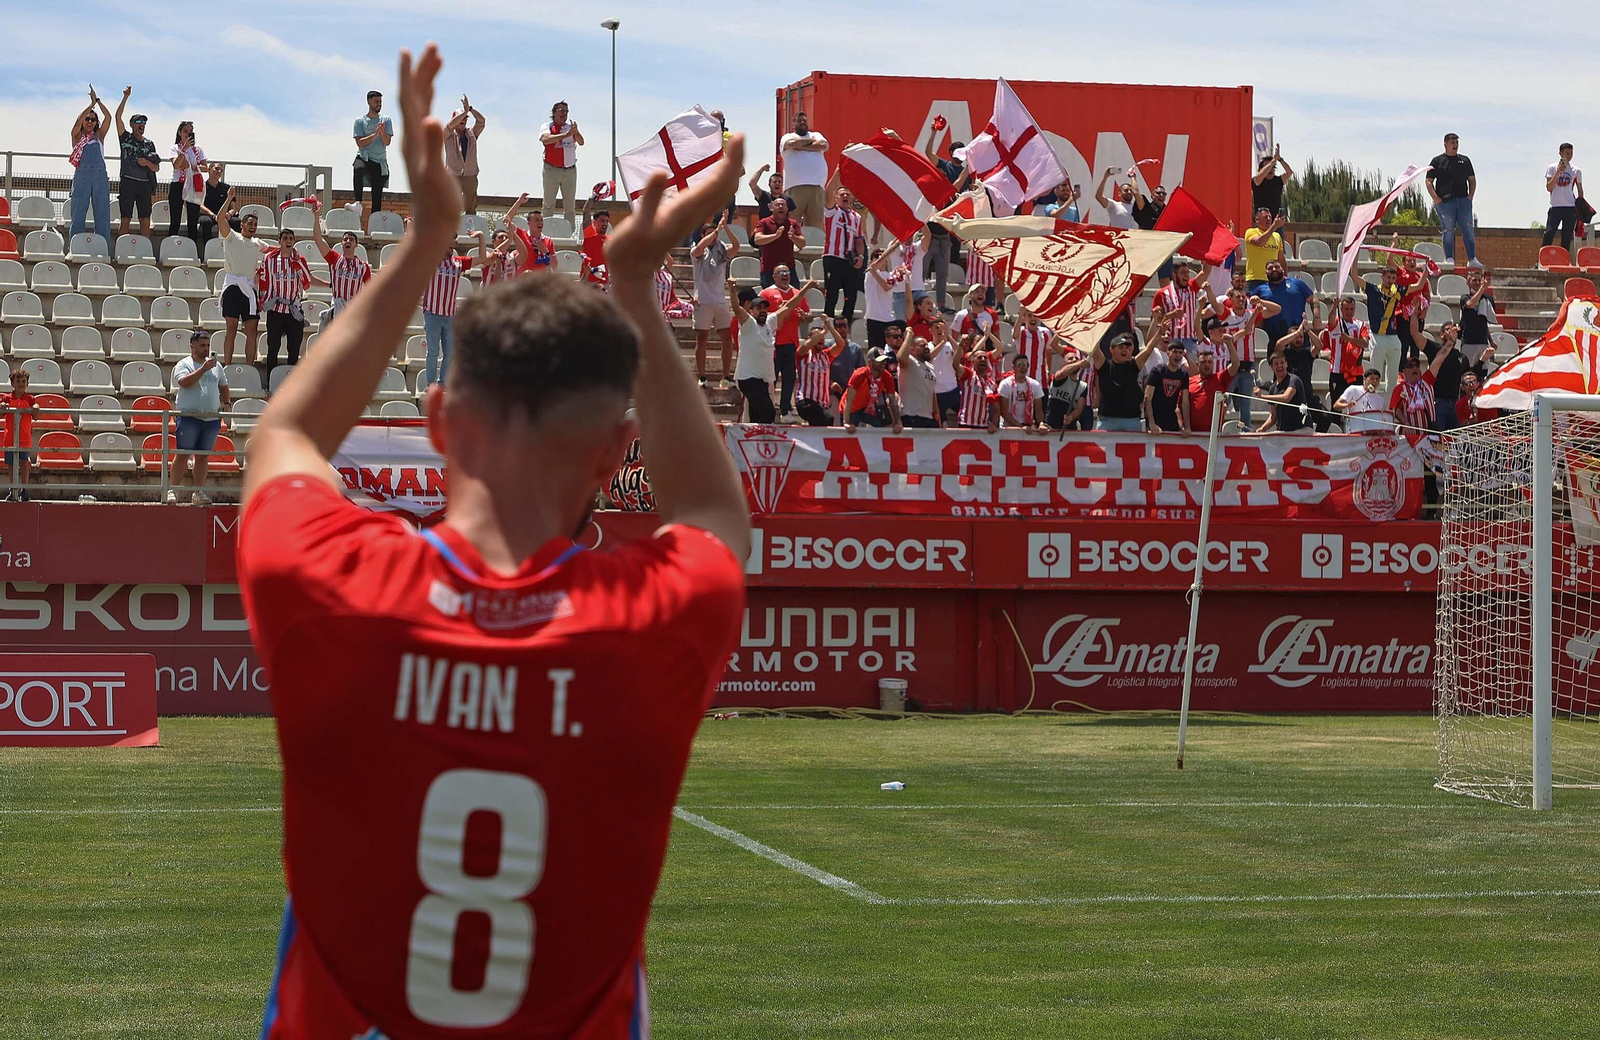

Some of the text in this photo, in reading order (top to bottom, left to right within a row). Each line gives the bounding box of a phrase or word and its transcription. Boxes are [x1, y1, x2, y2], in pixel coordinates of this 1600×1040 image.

[336, 467, 448, 498] OMAN
[815, 437, 1333, 506] ALGECIRAS
[1157, 509, 1197, 520] SUR
[771, 536, 967, 572] BESOCCER
[1078, 540, 1270, 573] BESOCCER
[394, 652, 583, 737] IVAN T.
[1107, 676, 1146, 689] Logística
[1147, 676, 1180, 689] Integral
[1194, 676, 1238, 689] transporte
[1321, 676, 1359, 690] Logística
[1360, 676, 1392, 689] Integral
[1393, 679, 1404, 688] en
[405, 768, 549, 1029] 8
